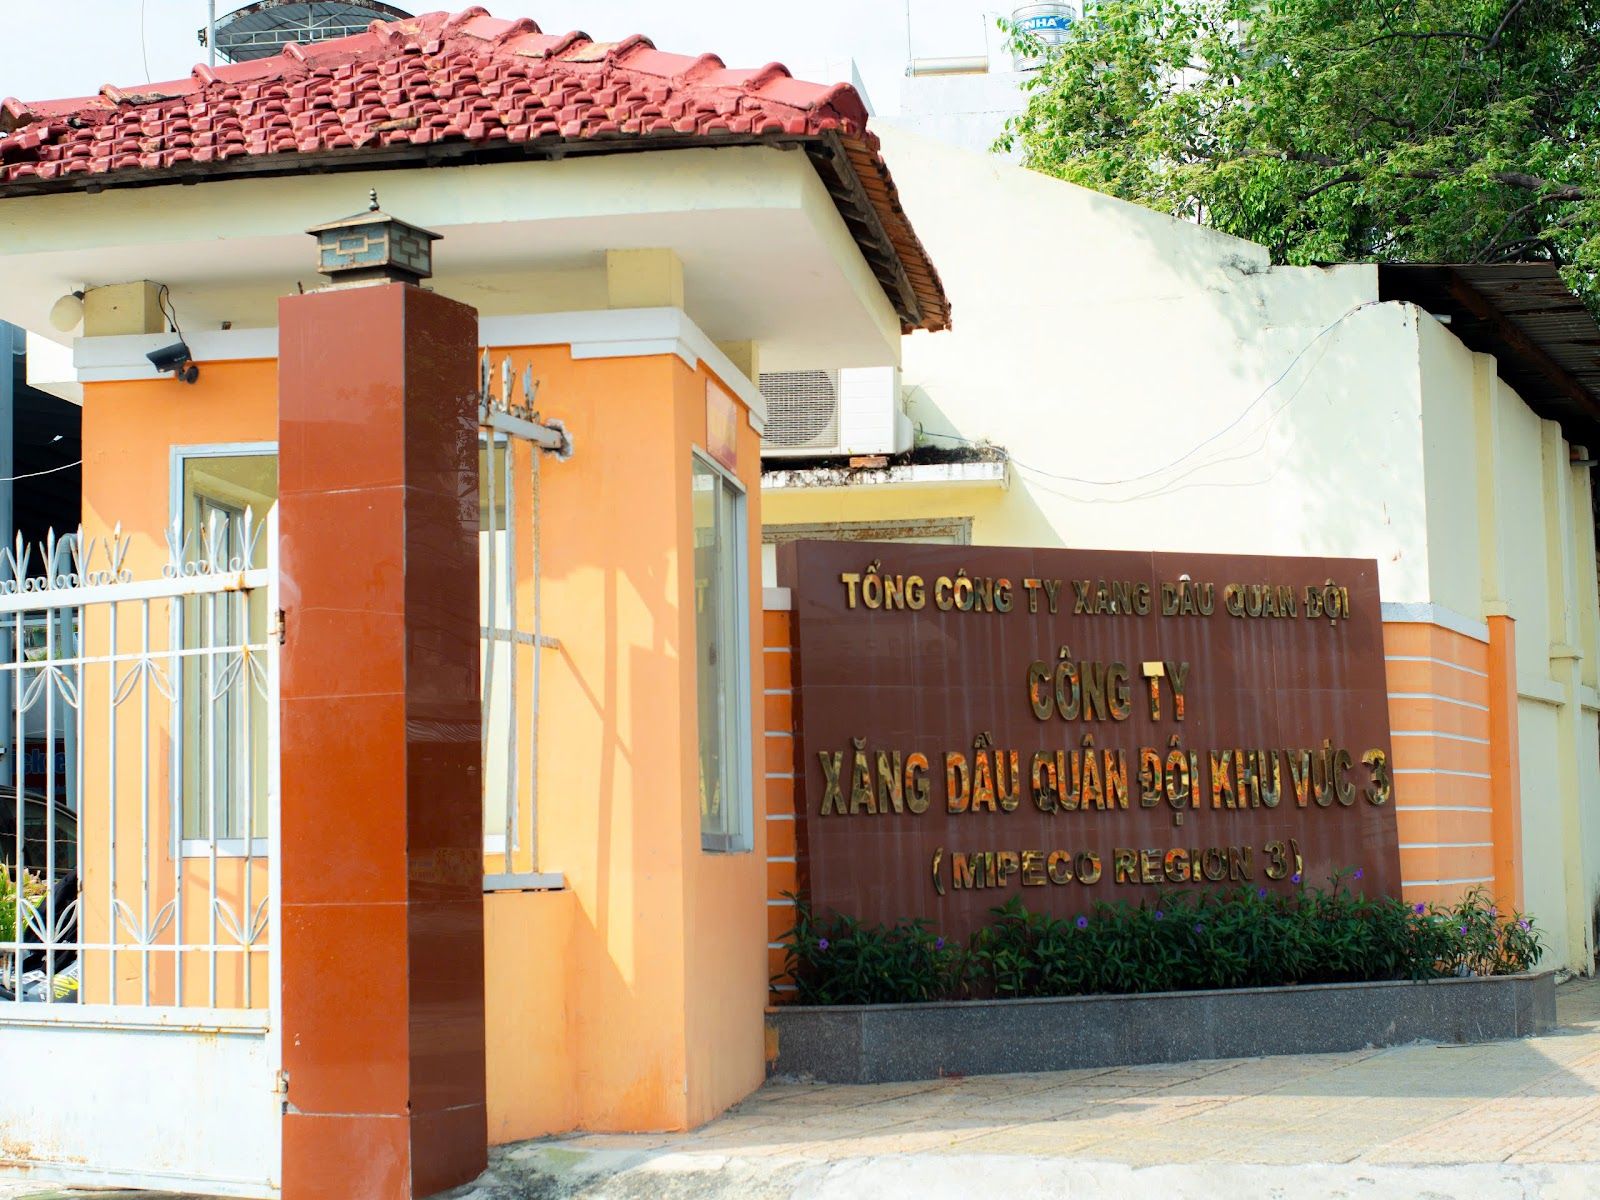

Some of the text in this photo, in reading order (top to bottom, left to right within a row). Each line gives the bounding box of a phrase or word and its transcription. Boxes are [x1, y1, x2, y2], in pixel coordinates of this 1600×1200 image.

[841, 559, 926, 611] TỔNG
[934, 568, 1014, 613] CÔNG
[1023, 578, 1062, 614] TY
[1303, 577, 1350, 626] ĐỘI
[1028, 645, 1190, 721] CÔNG TY
[818, 736, 931, 816] XĂNG
[946, 731, 1021, 814] DẦU
[1032, 733, 1129, 816] QUÂN
[1137, 734, 1200, 826] ĐỘI
[1210, 748, 1281, 809] KHU
[1361, 748, 1391, 807] 3
[1113, 846, 1253, 884] REGION
